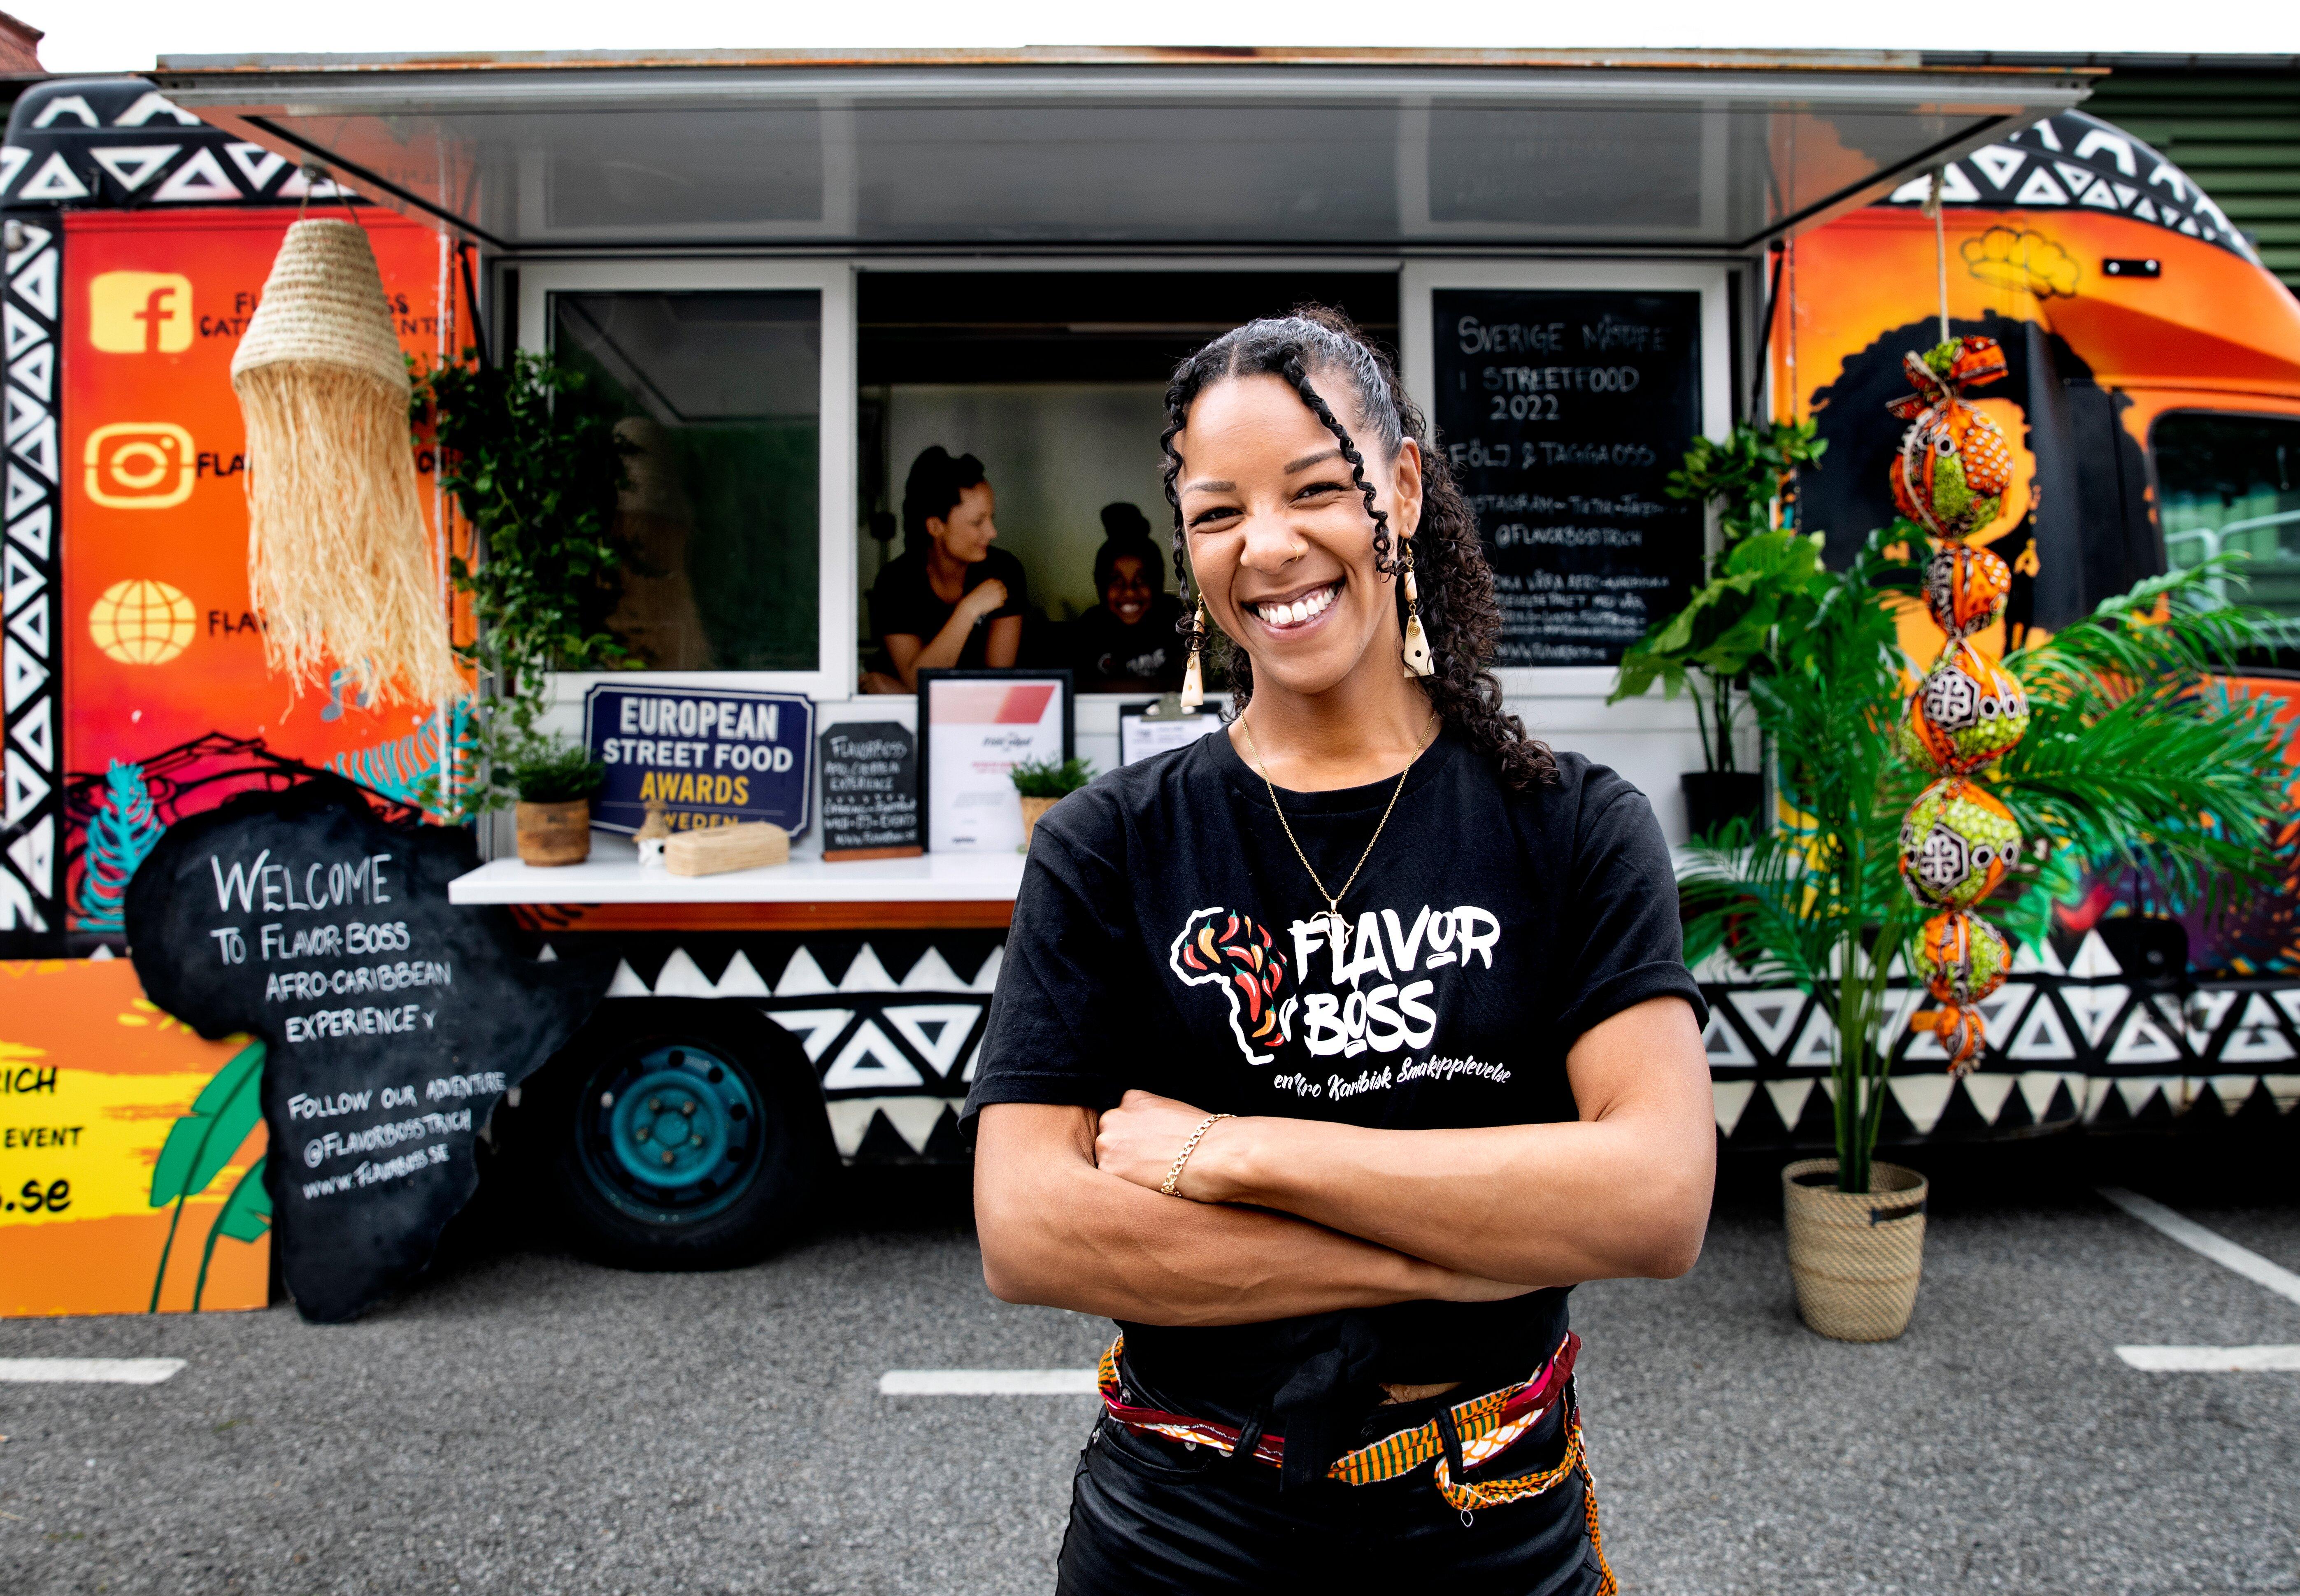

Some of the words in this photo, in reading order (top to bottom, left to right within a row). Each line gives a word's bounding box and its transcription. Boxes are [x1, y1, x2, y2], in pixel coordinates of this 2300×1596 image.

[1458, 316, 1564, 355] SVERIGE
[1460, 370, 1467, 392] I
[1483, 366, 1640, 393] STREETFOOD
[1490, 394, 1560, 420] 2022
[1449, 438, 1511, 467] FÖLJ
[621, 696, 779, 741] EUROPEAN
[603, 739, 710, 768] STREET
[714, 744, 793, 773] FOOD
[639, 771, 749, 805] AWARDS
[663, 812, 739, 831] WEDEN
[211, 849, 391, 913] WELCOME
[210, 927, 246, 965] TO
[346, 921, 411, 954] BOSS
[1288, 905, 1501, 991] FLAVOR
[285, 1005, 420, 1042] EXPERIENCE
[1303, 980, 1437, 1059] BOSS
[0, 1066, 57, 1093] ICH
[1327, 1065, 1392, 1101] Karibisk
[288, 1089, 373, 1120] FOLLOW
[380, 1085, 418, 1110] OUR
[5, 1127, 84, 1148] EVENT
